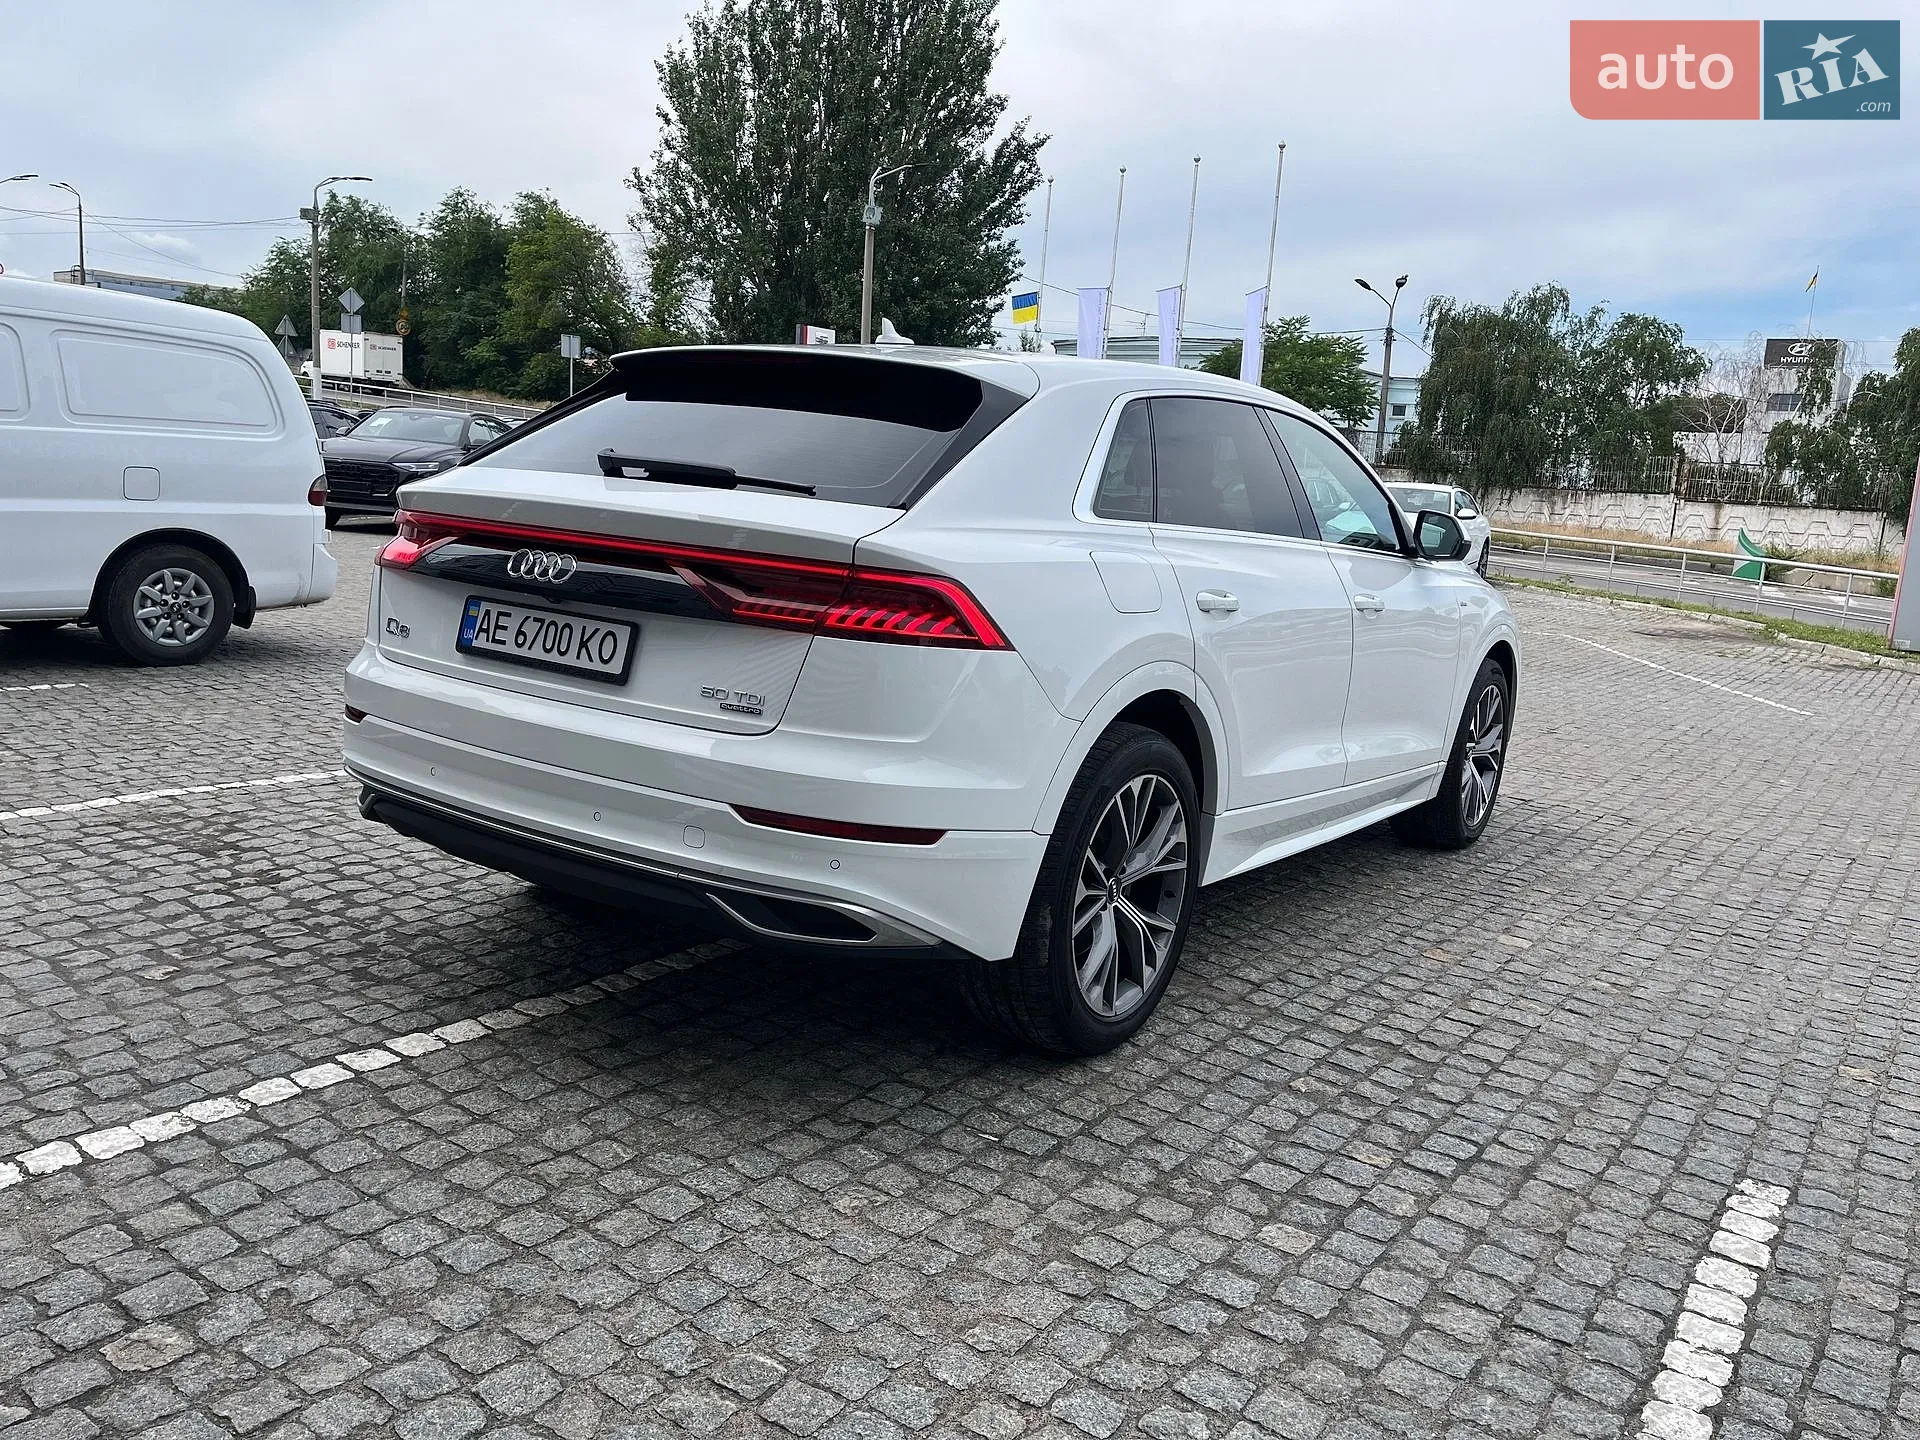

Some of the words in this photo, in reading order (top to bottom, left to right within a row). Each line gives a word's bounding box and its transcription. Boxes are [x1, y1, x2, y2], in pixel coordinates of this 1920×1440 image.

[1780, 356, 1815, 364] HYUN
[385, 617, 410, 639] Q8
[463, 628, 473, 640] UA
[475, 608, 512, 646] AE
[514, 616, 574, 657] 6700
[576, 625, 618, 665] KO
[700, 685, 729, 700] 50
[734, 690, 766, 707] TDI
[720, 703, 761, 715] quattro
